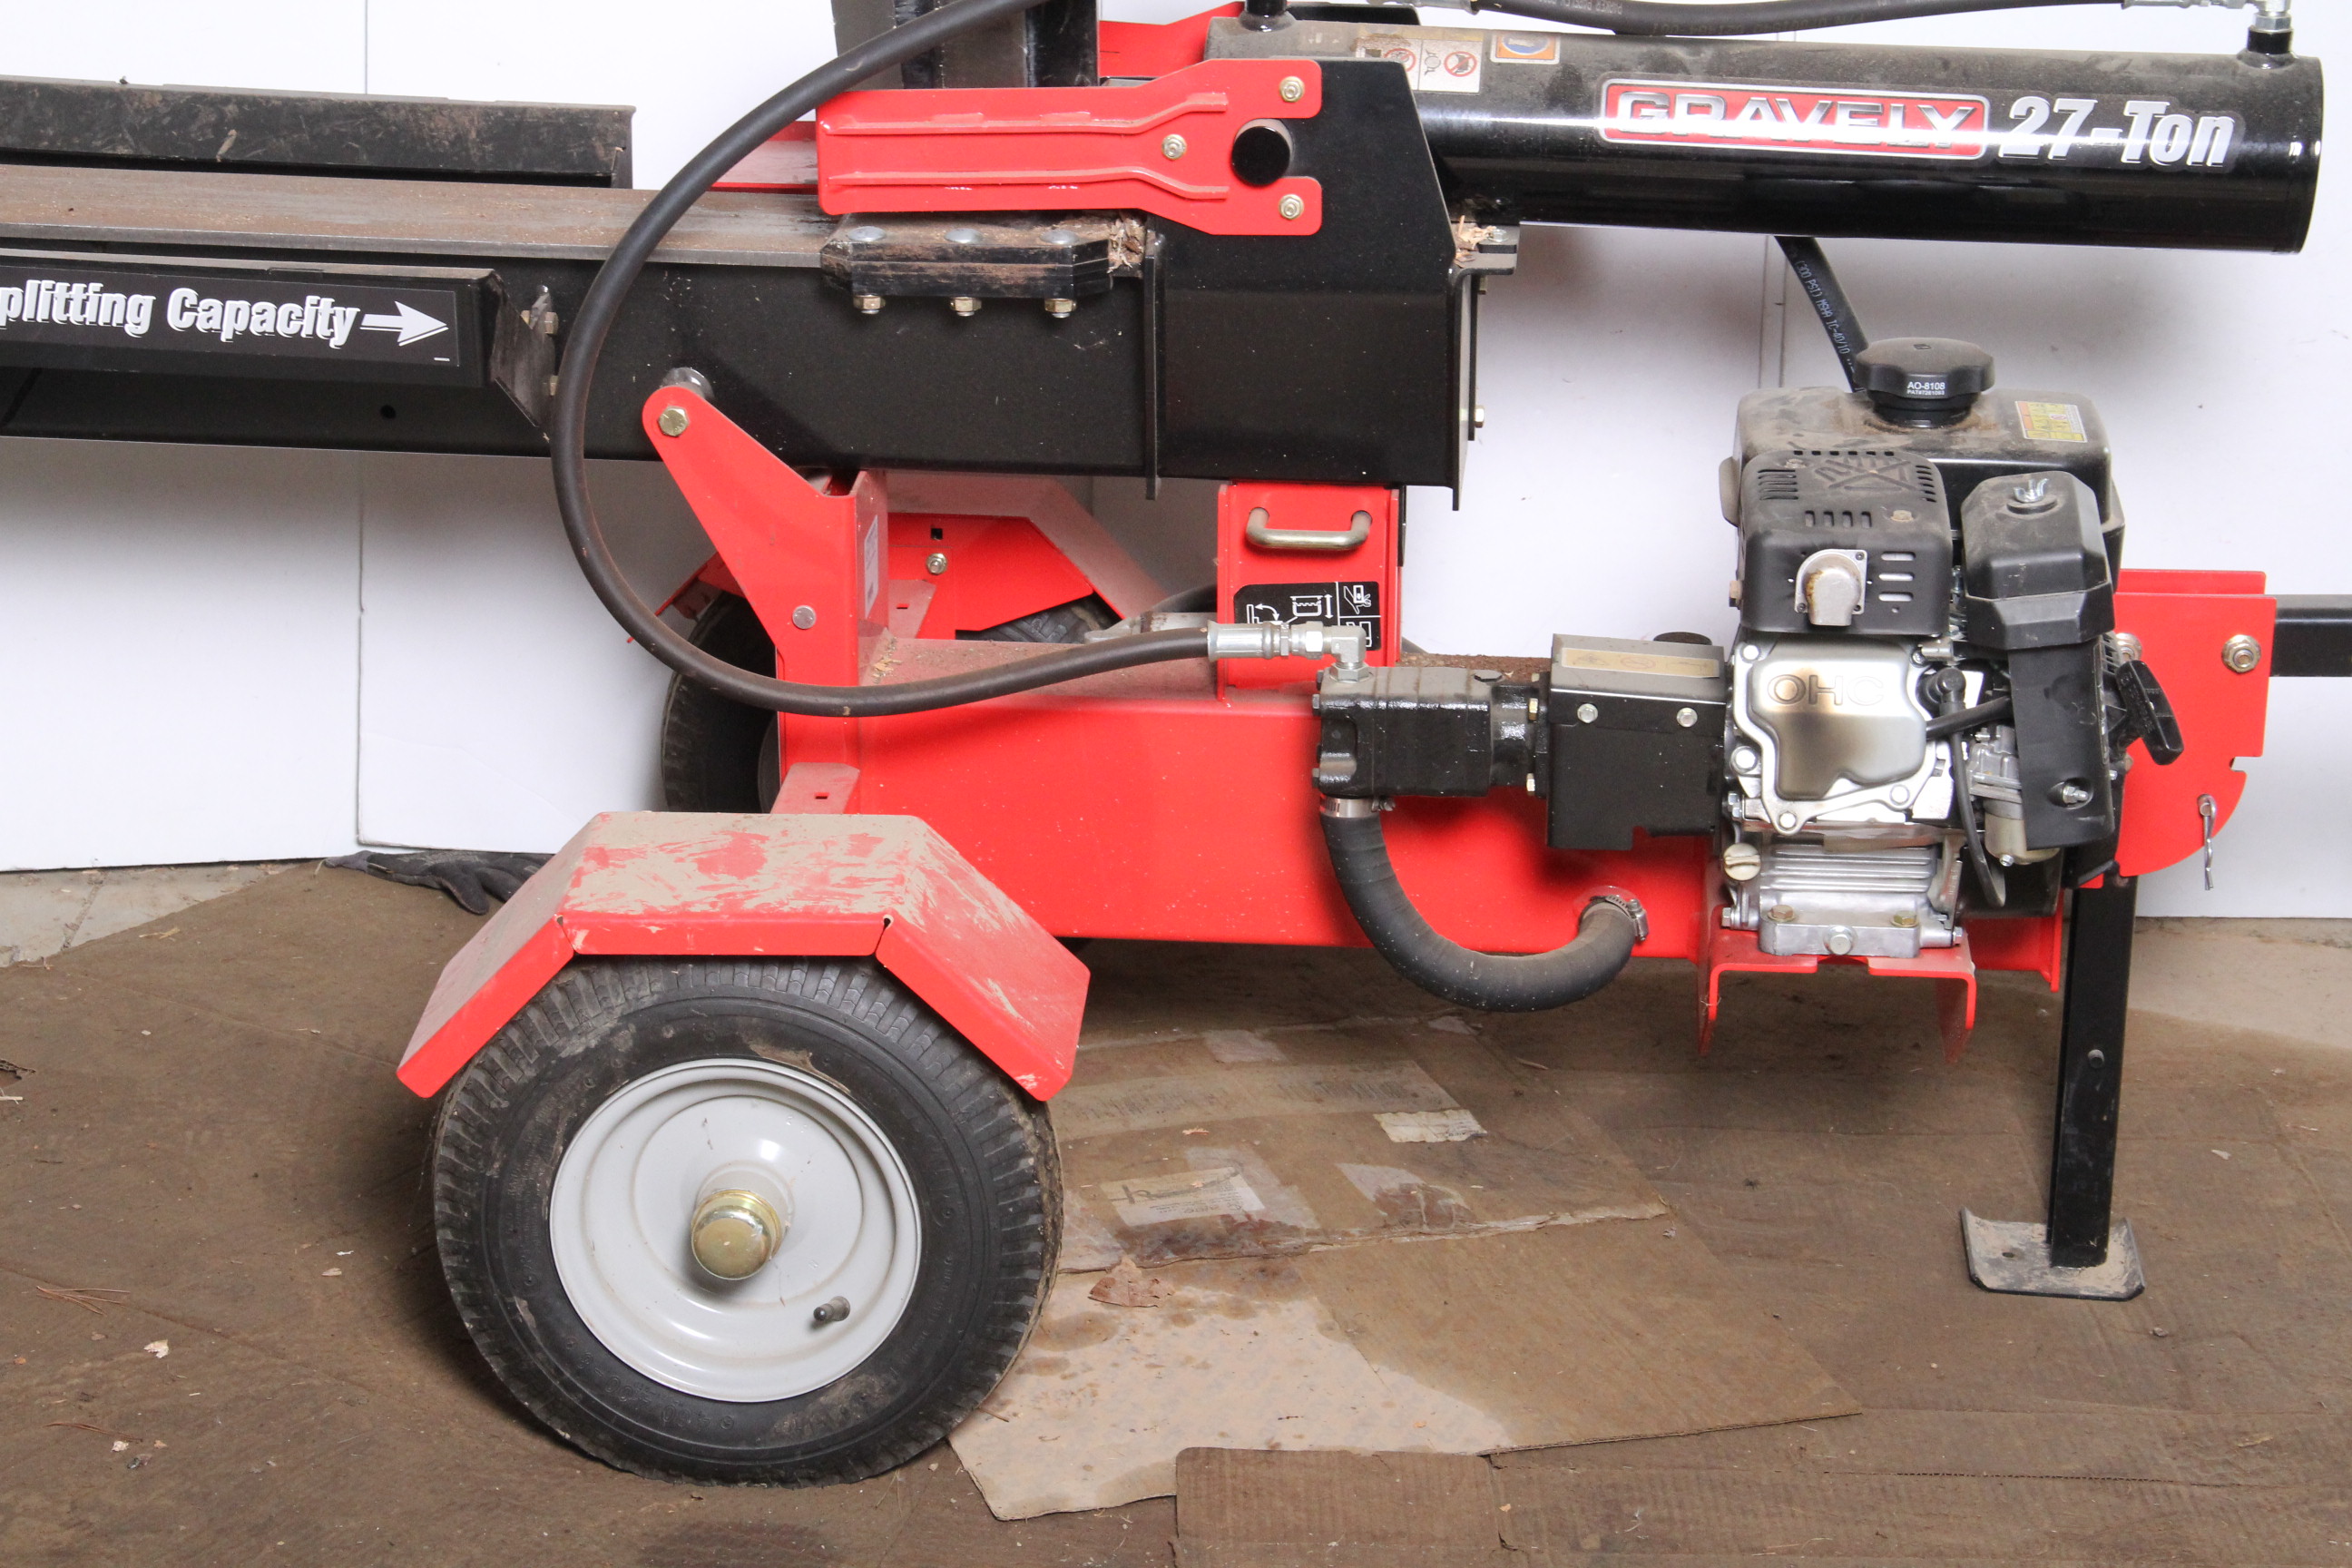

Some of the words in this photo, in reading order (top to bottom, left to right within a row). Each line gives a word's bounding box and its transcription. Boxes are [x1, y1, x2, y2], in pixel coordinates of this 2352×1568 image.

[1616, 92, 1977, 149] GRAVELY
[1997, 95, 2236, 167] 27-Ton
[0, 279, 156, 338] plitting
[166, 288, 361, 349] Capacity
[1906, 381, 1945, 390] AO-8108
[1767, 674, 1885, 706] OHC
